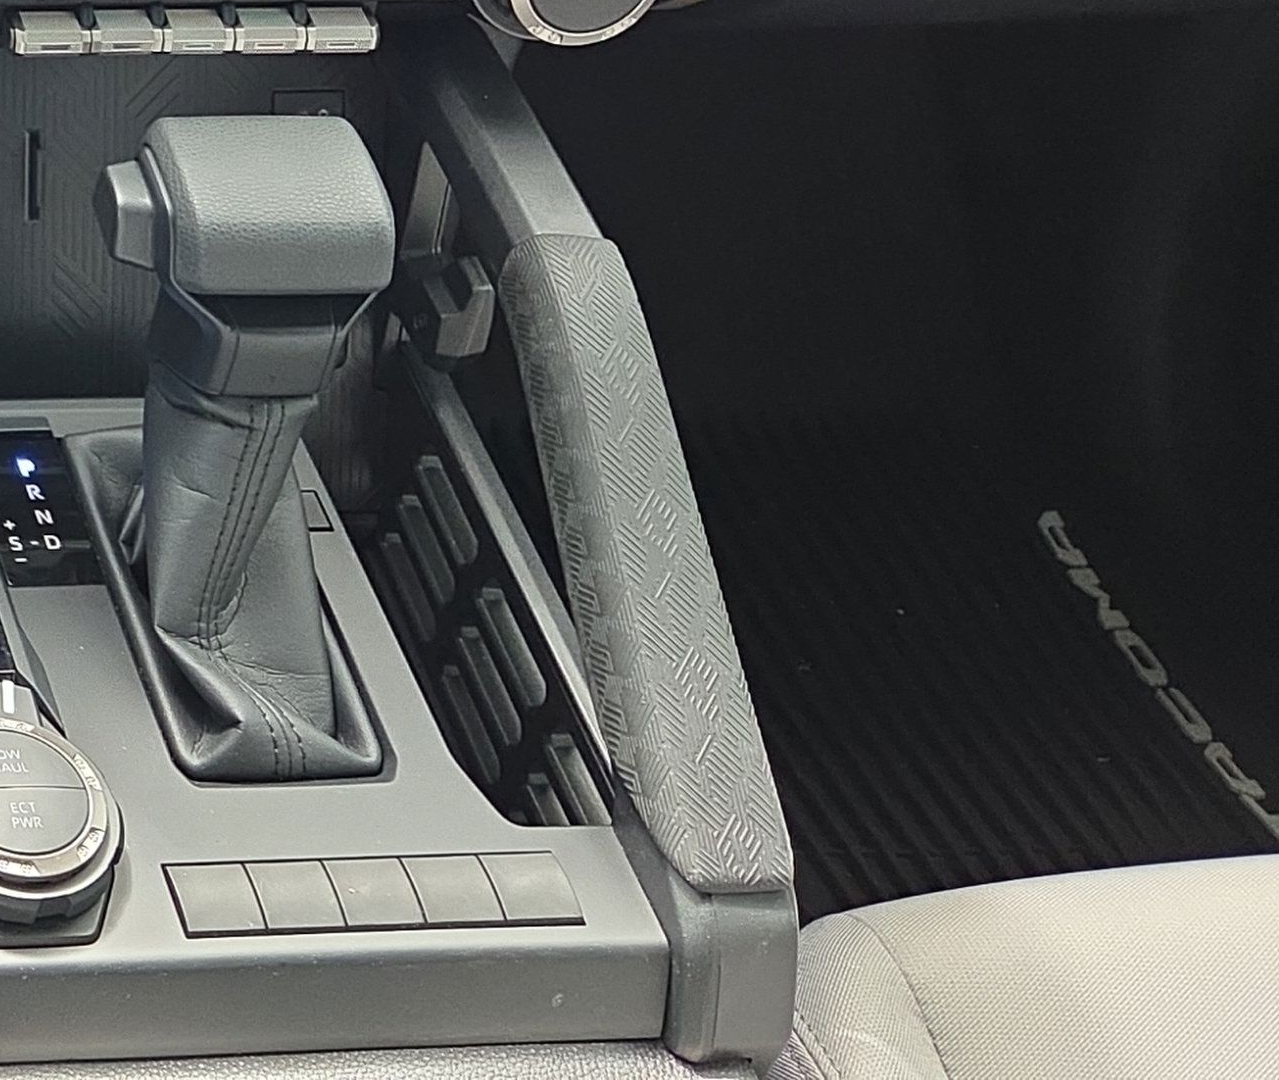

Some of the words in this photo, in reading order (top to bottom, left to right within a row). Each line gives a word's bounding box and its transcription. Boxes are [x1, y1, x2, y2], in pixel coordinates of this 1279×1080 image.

[16, 457, 36, 478] P
[26, 484, 44, 500] R
[34, 509, 54, 525] N
[9, 536, 23, 552] S
[44, 534, 61, 550] D
[10, 802, 36, 813] ECT
[12, 817, 43, 829] PWR
